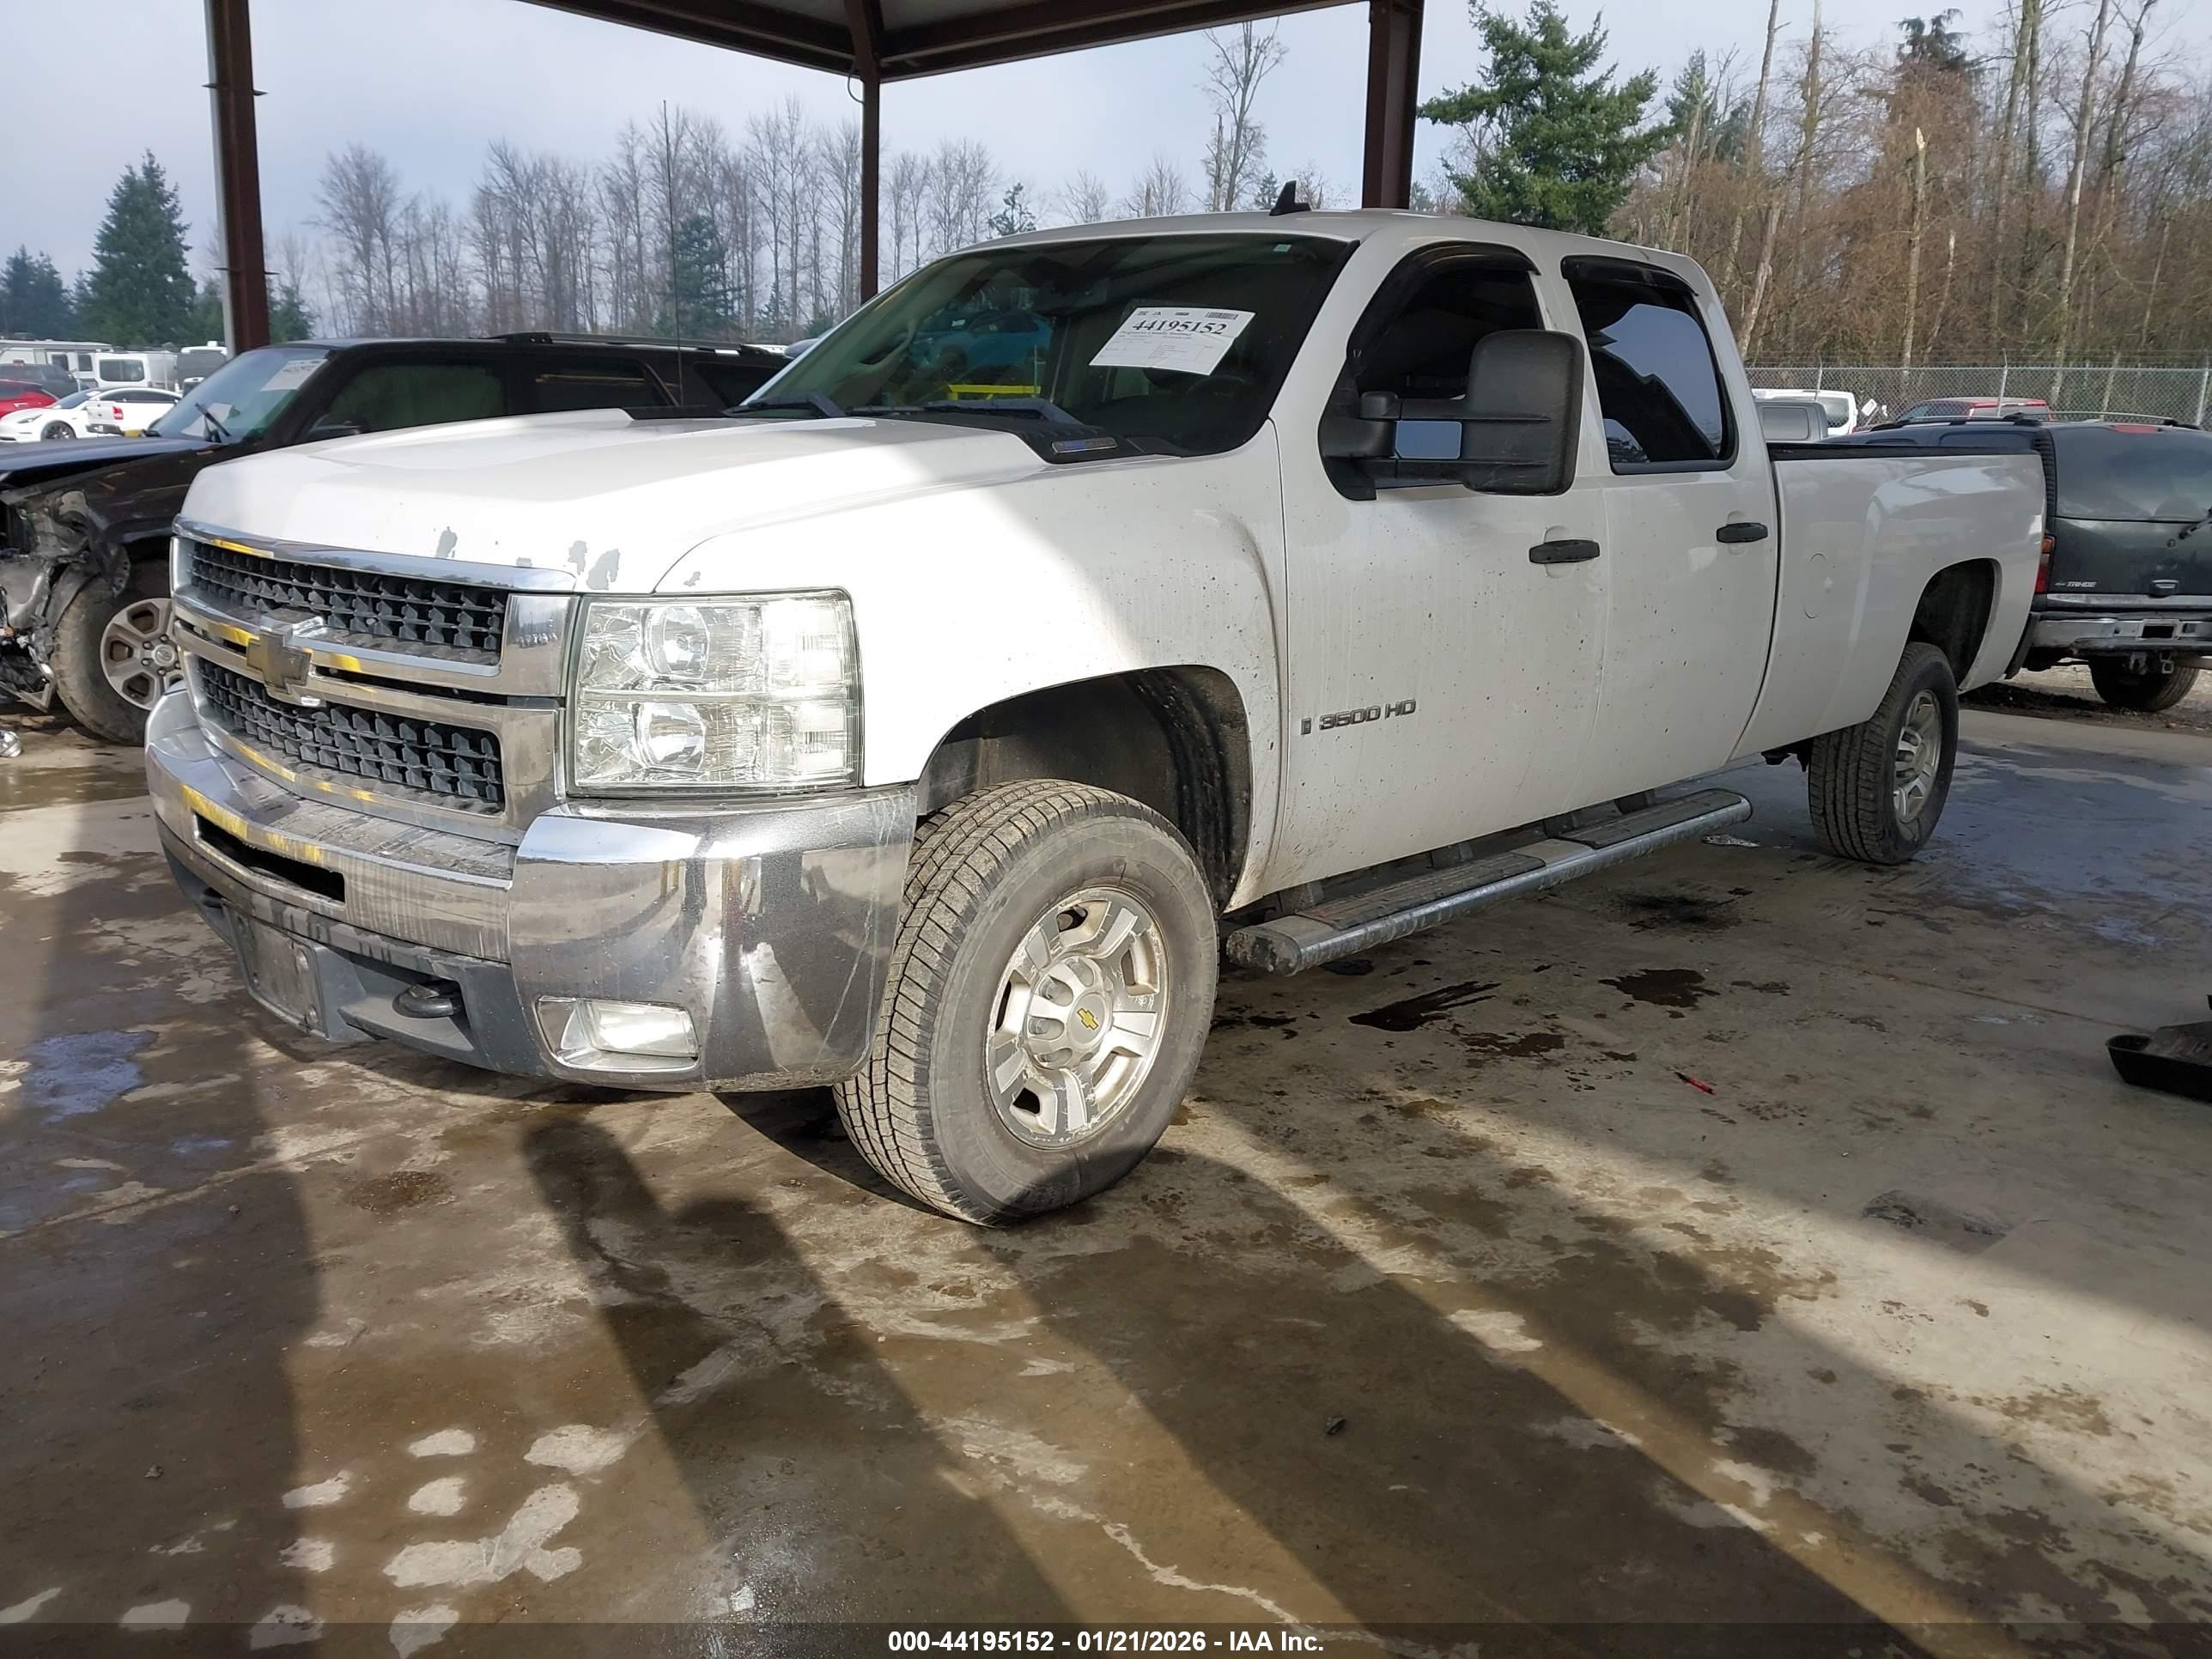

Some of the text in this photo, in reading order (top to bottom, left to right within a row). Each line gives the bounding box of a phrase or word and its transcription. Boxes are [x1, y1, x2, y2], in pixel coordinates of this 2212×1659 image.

[1133, 319, 1227, 334] 44195152
[1319, 698, 1417, 731] 3500 HD
